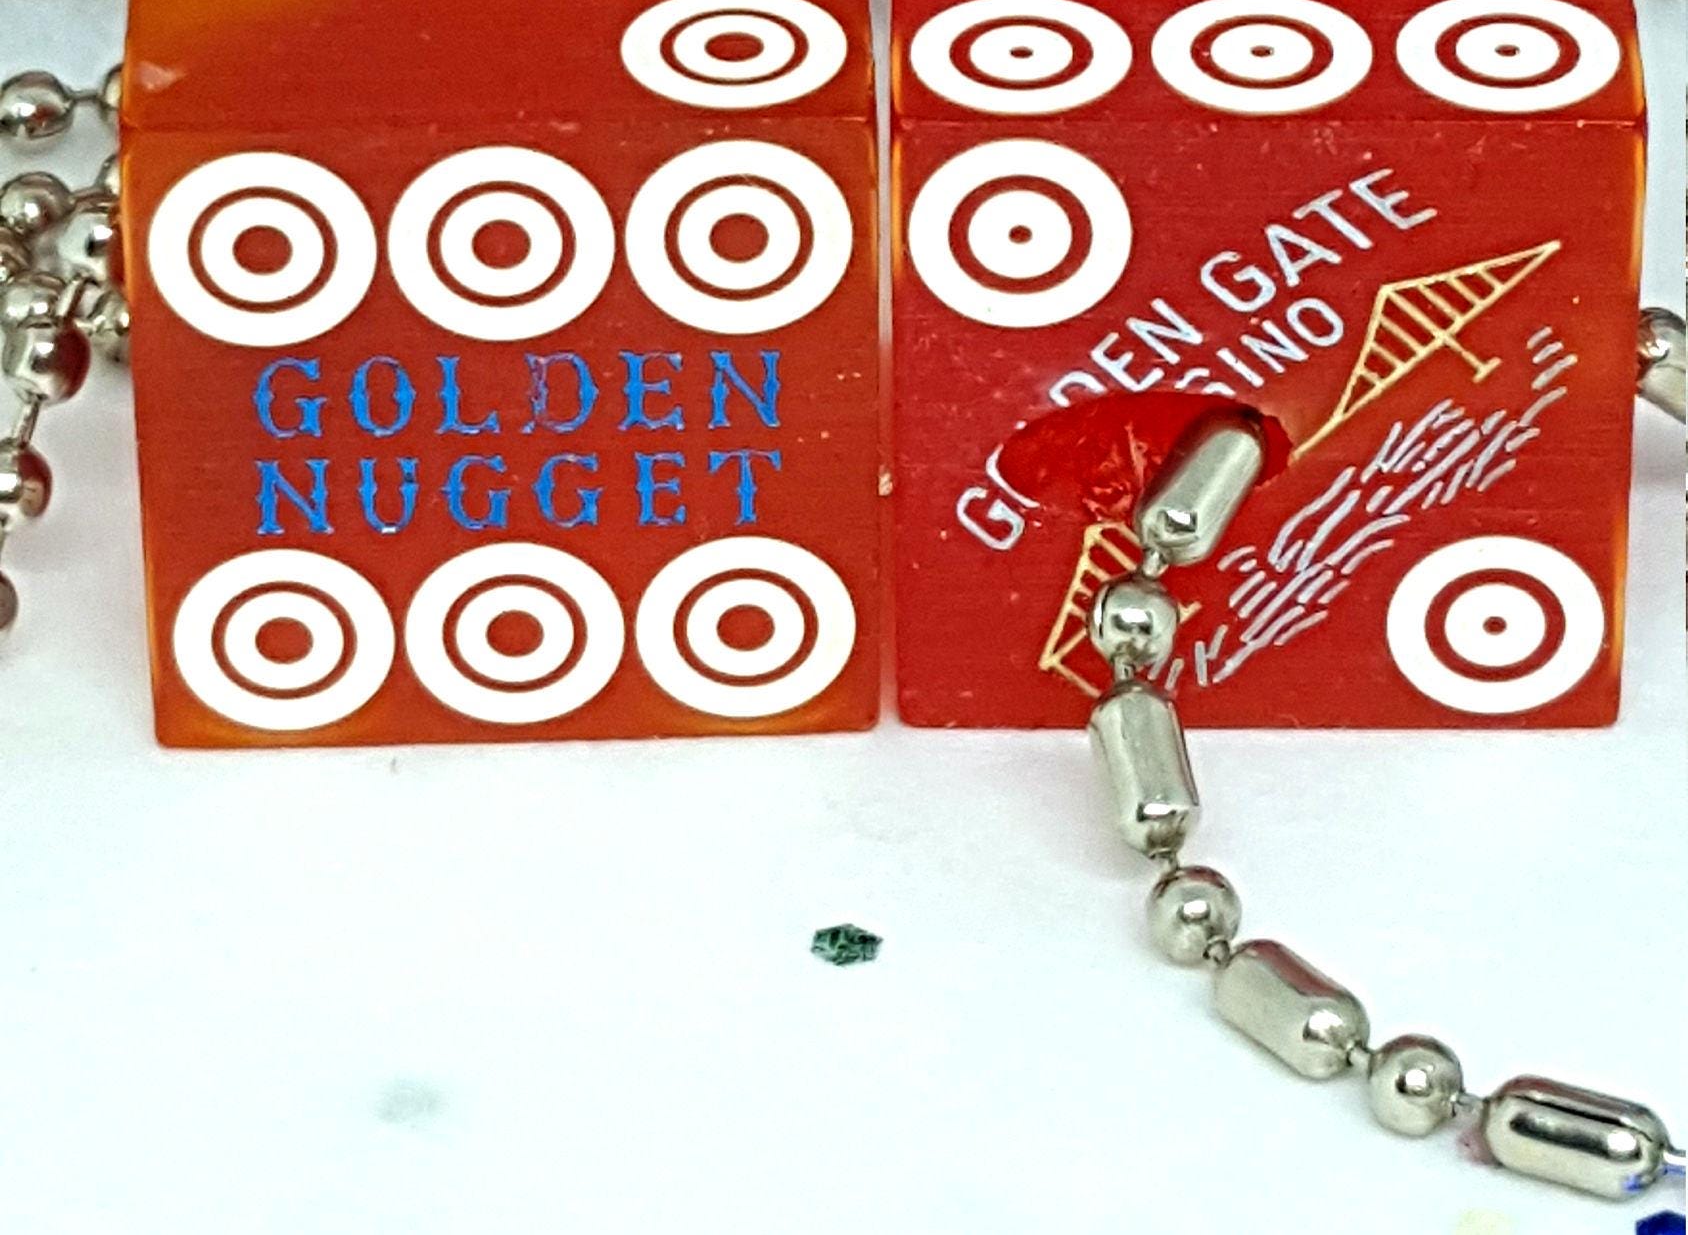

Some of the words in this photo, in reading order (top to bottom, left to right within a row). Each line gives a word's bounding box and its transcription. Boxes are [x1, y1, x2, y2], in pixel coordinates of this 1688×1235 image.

[1200, 168, 1438, 314] GATE
[252, 350, 782, 439] GOLDEN
[255, 450, 783, 536] NUGGET
